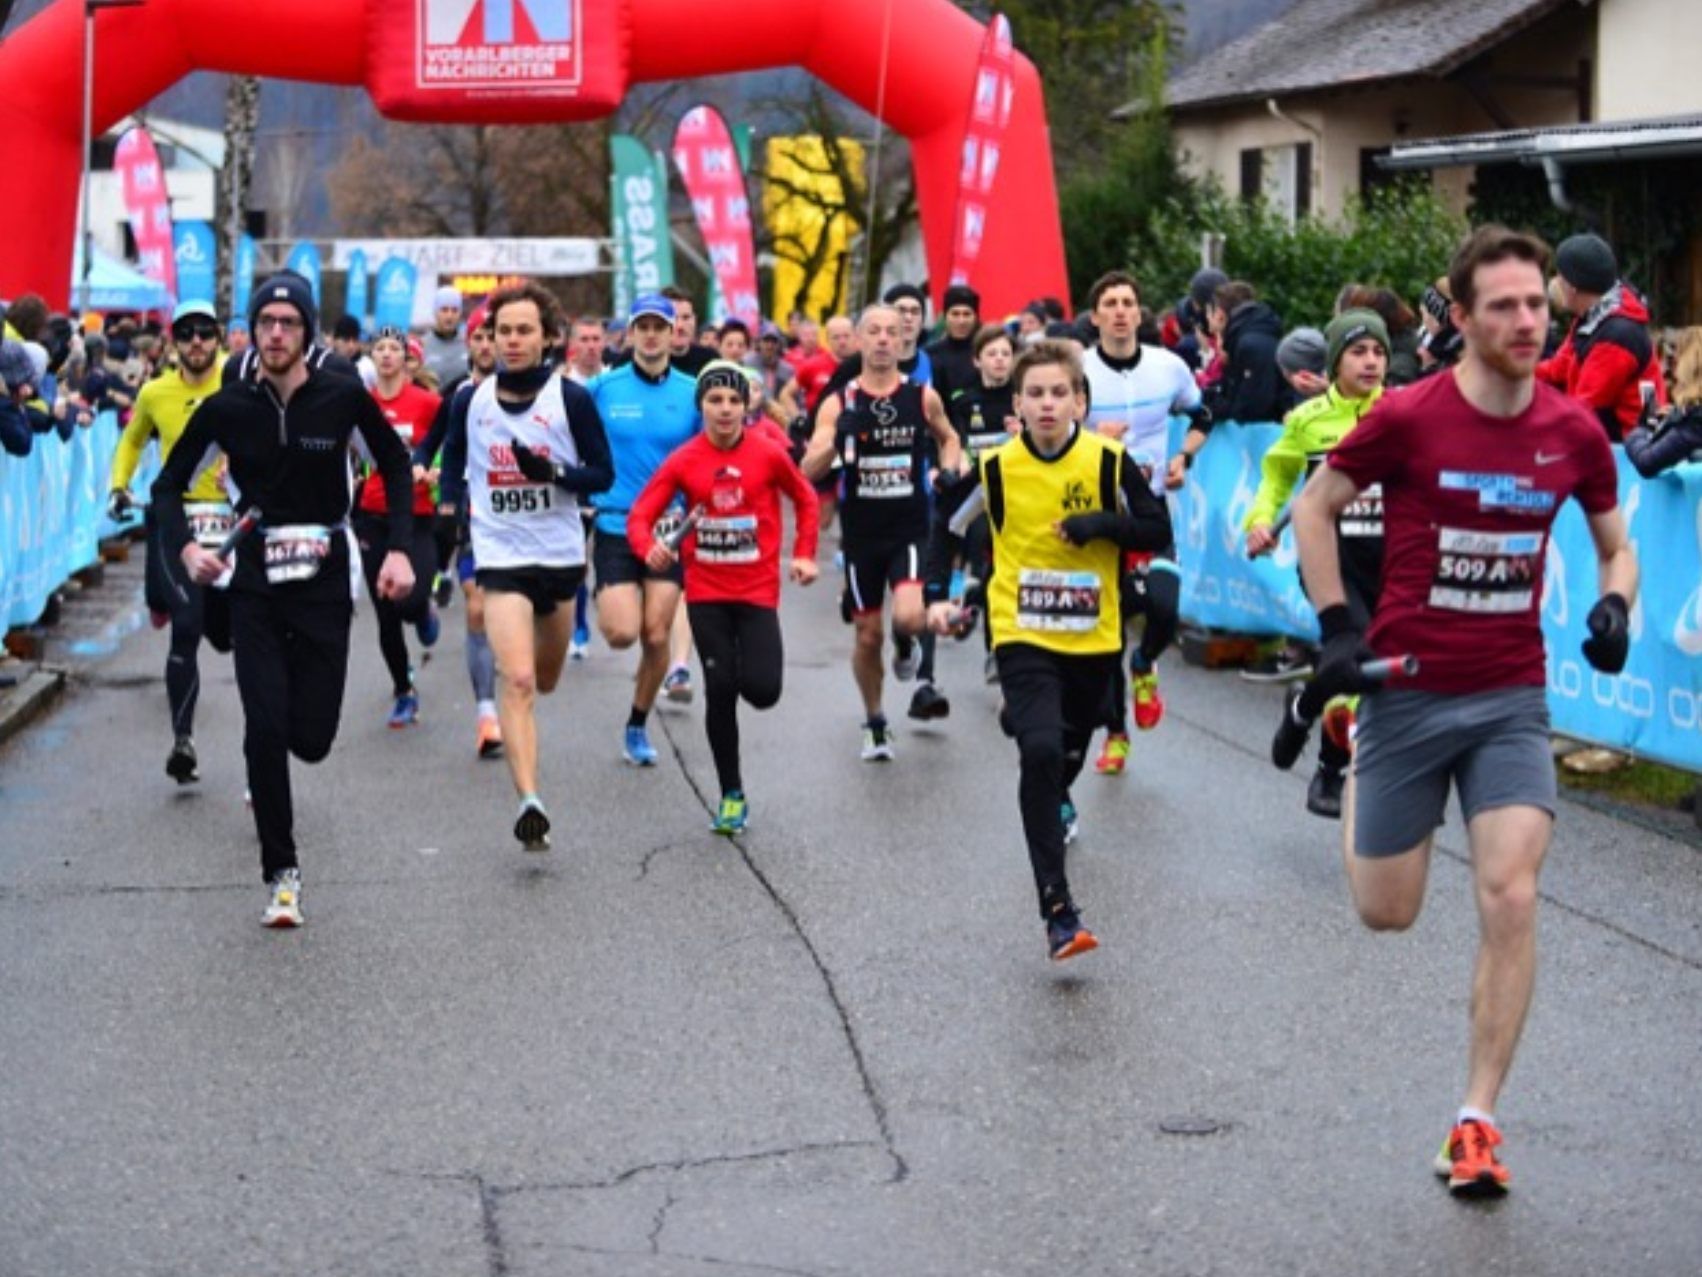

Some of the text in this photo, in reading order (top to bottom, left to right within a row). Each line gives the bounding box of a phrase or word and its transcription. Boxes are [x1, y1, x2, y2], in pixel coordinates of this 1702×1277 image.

[426, 46, 570, 61] VORARLBERGER
[426, 61, 555, 77] NACHRICHTEN
[489, 244, 545, 271] ZIEL
[491, 488, 551, 513] 9951
[1061, 496, 1093, 510] KTV
[1438, 554, 1507, 582] 509 A
[1020, 588, 1074, 609] 589 A
